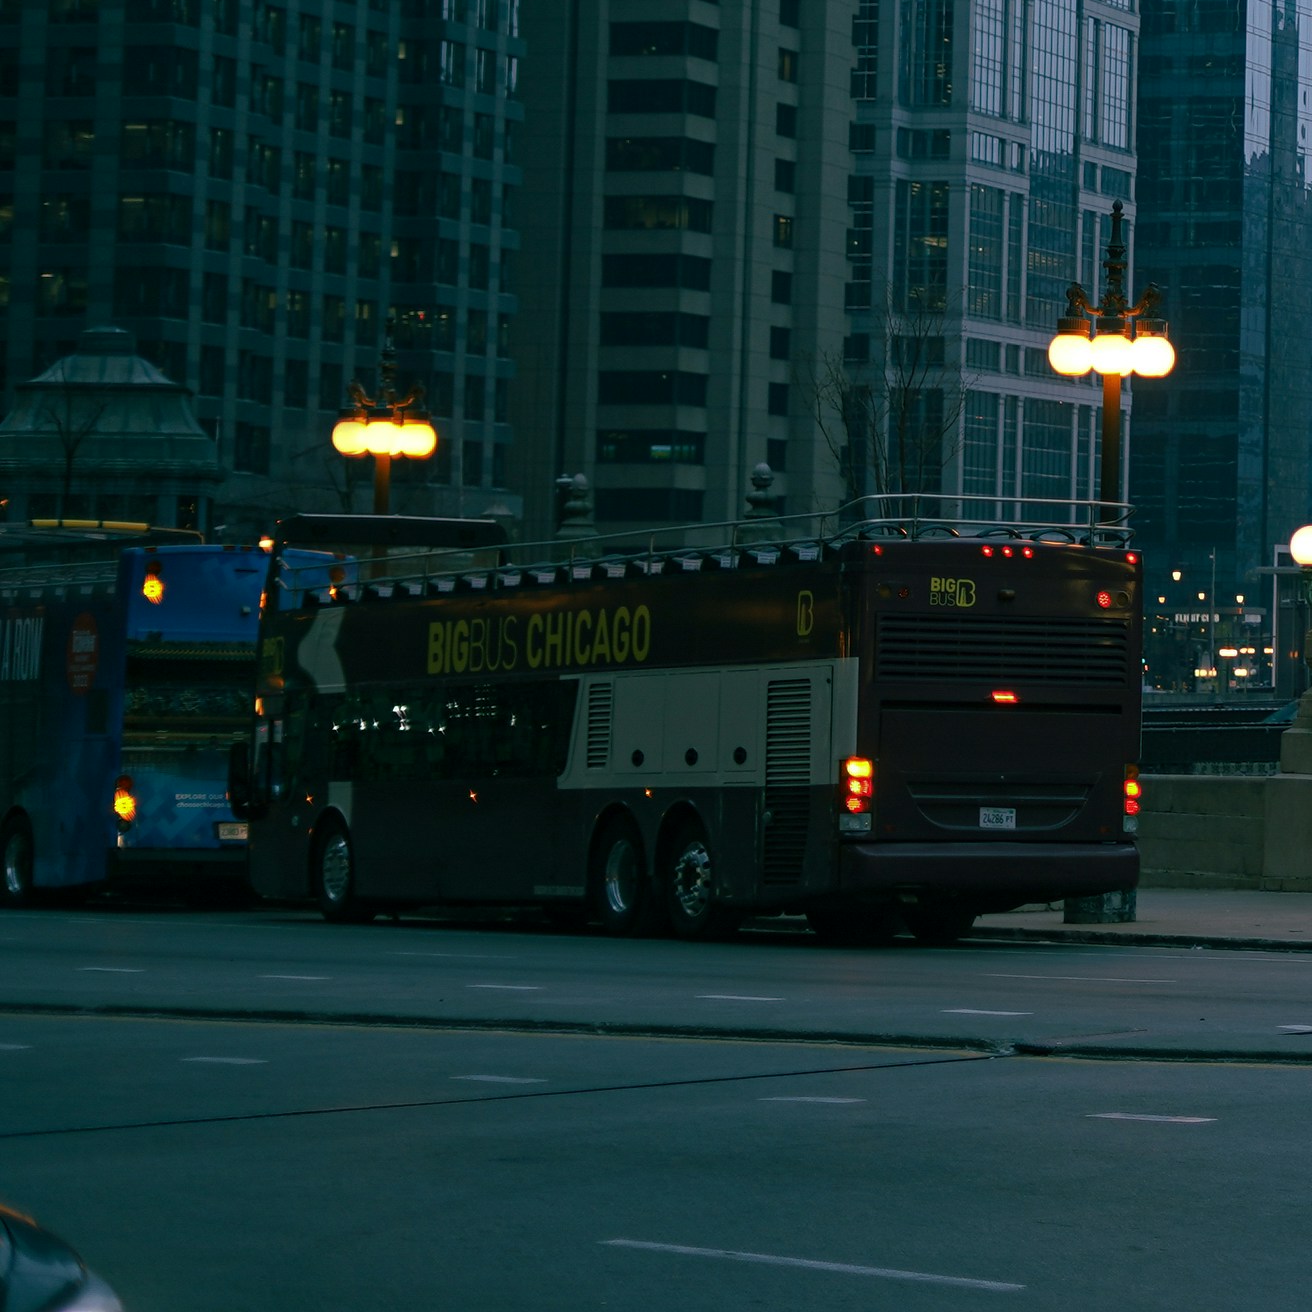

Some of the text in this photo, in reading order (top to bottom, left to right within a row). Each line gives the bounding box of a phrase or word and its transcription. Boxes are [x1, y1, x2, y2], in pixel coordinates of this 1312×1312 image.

[930, 577, 956, 592] BIG
[930, 592, 956, 607] BUS
[1201, 613, 1220, 623] CLB
[526, 604, 651, 669] CHICAGO
[12, 616, 44, 681] ROW
